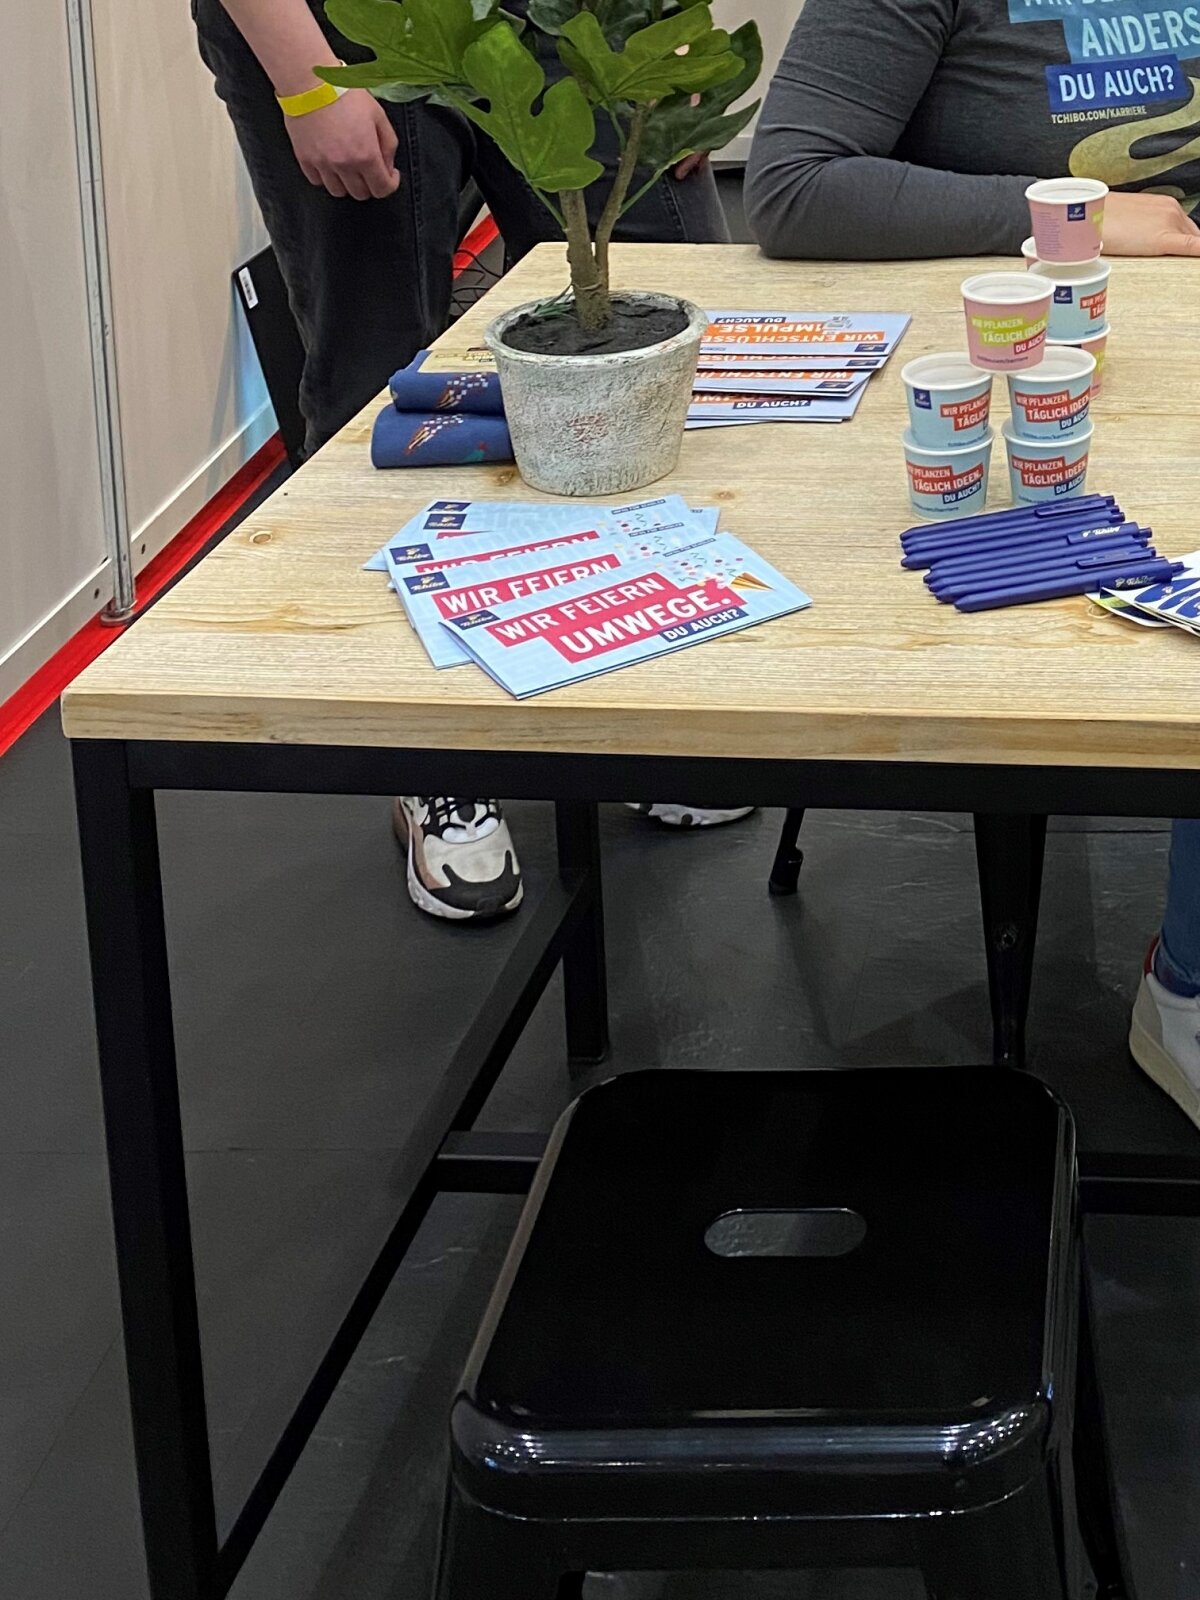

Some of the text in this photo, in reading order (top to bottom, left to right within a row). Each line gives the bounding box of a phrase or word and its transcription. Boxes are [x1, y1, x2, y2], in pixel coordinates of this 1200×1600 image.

[1058, 64, 1175, 102] DU AUCH?
[1051, 105, 1147, 124] TCHIBO.COM/KARRIERE
[842, 332, 880, 342] WIR
[764, 400, 808, 408] AUCH?
[1028, 394, 1068, 407] PFLANZEN
[942, 407, 958, 416] WIR
[1027, 406, 1068, 420] TÄGLICH
[1061, 418, 1072, 428] DU
[1024, 460, 1063, 472] PFLANZEN
[914, 478, 951, 492] TÄGLICH
[1023, 472, 1063, 485] TÄGLICH
[1056, 484, 1067, 494] DU
[944, 494, 956, 503] DU
[441, 586, 501, 615] WIR
[495, 576, 665, 641] WIR FEIERN
[559, 588, 732, 654] UMWEGE.
[664, 608, 740, 641] DU AUCH?
